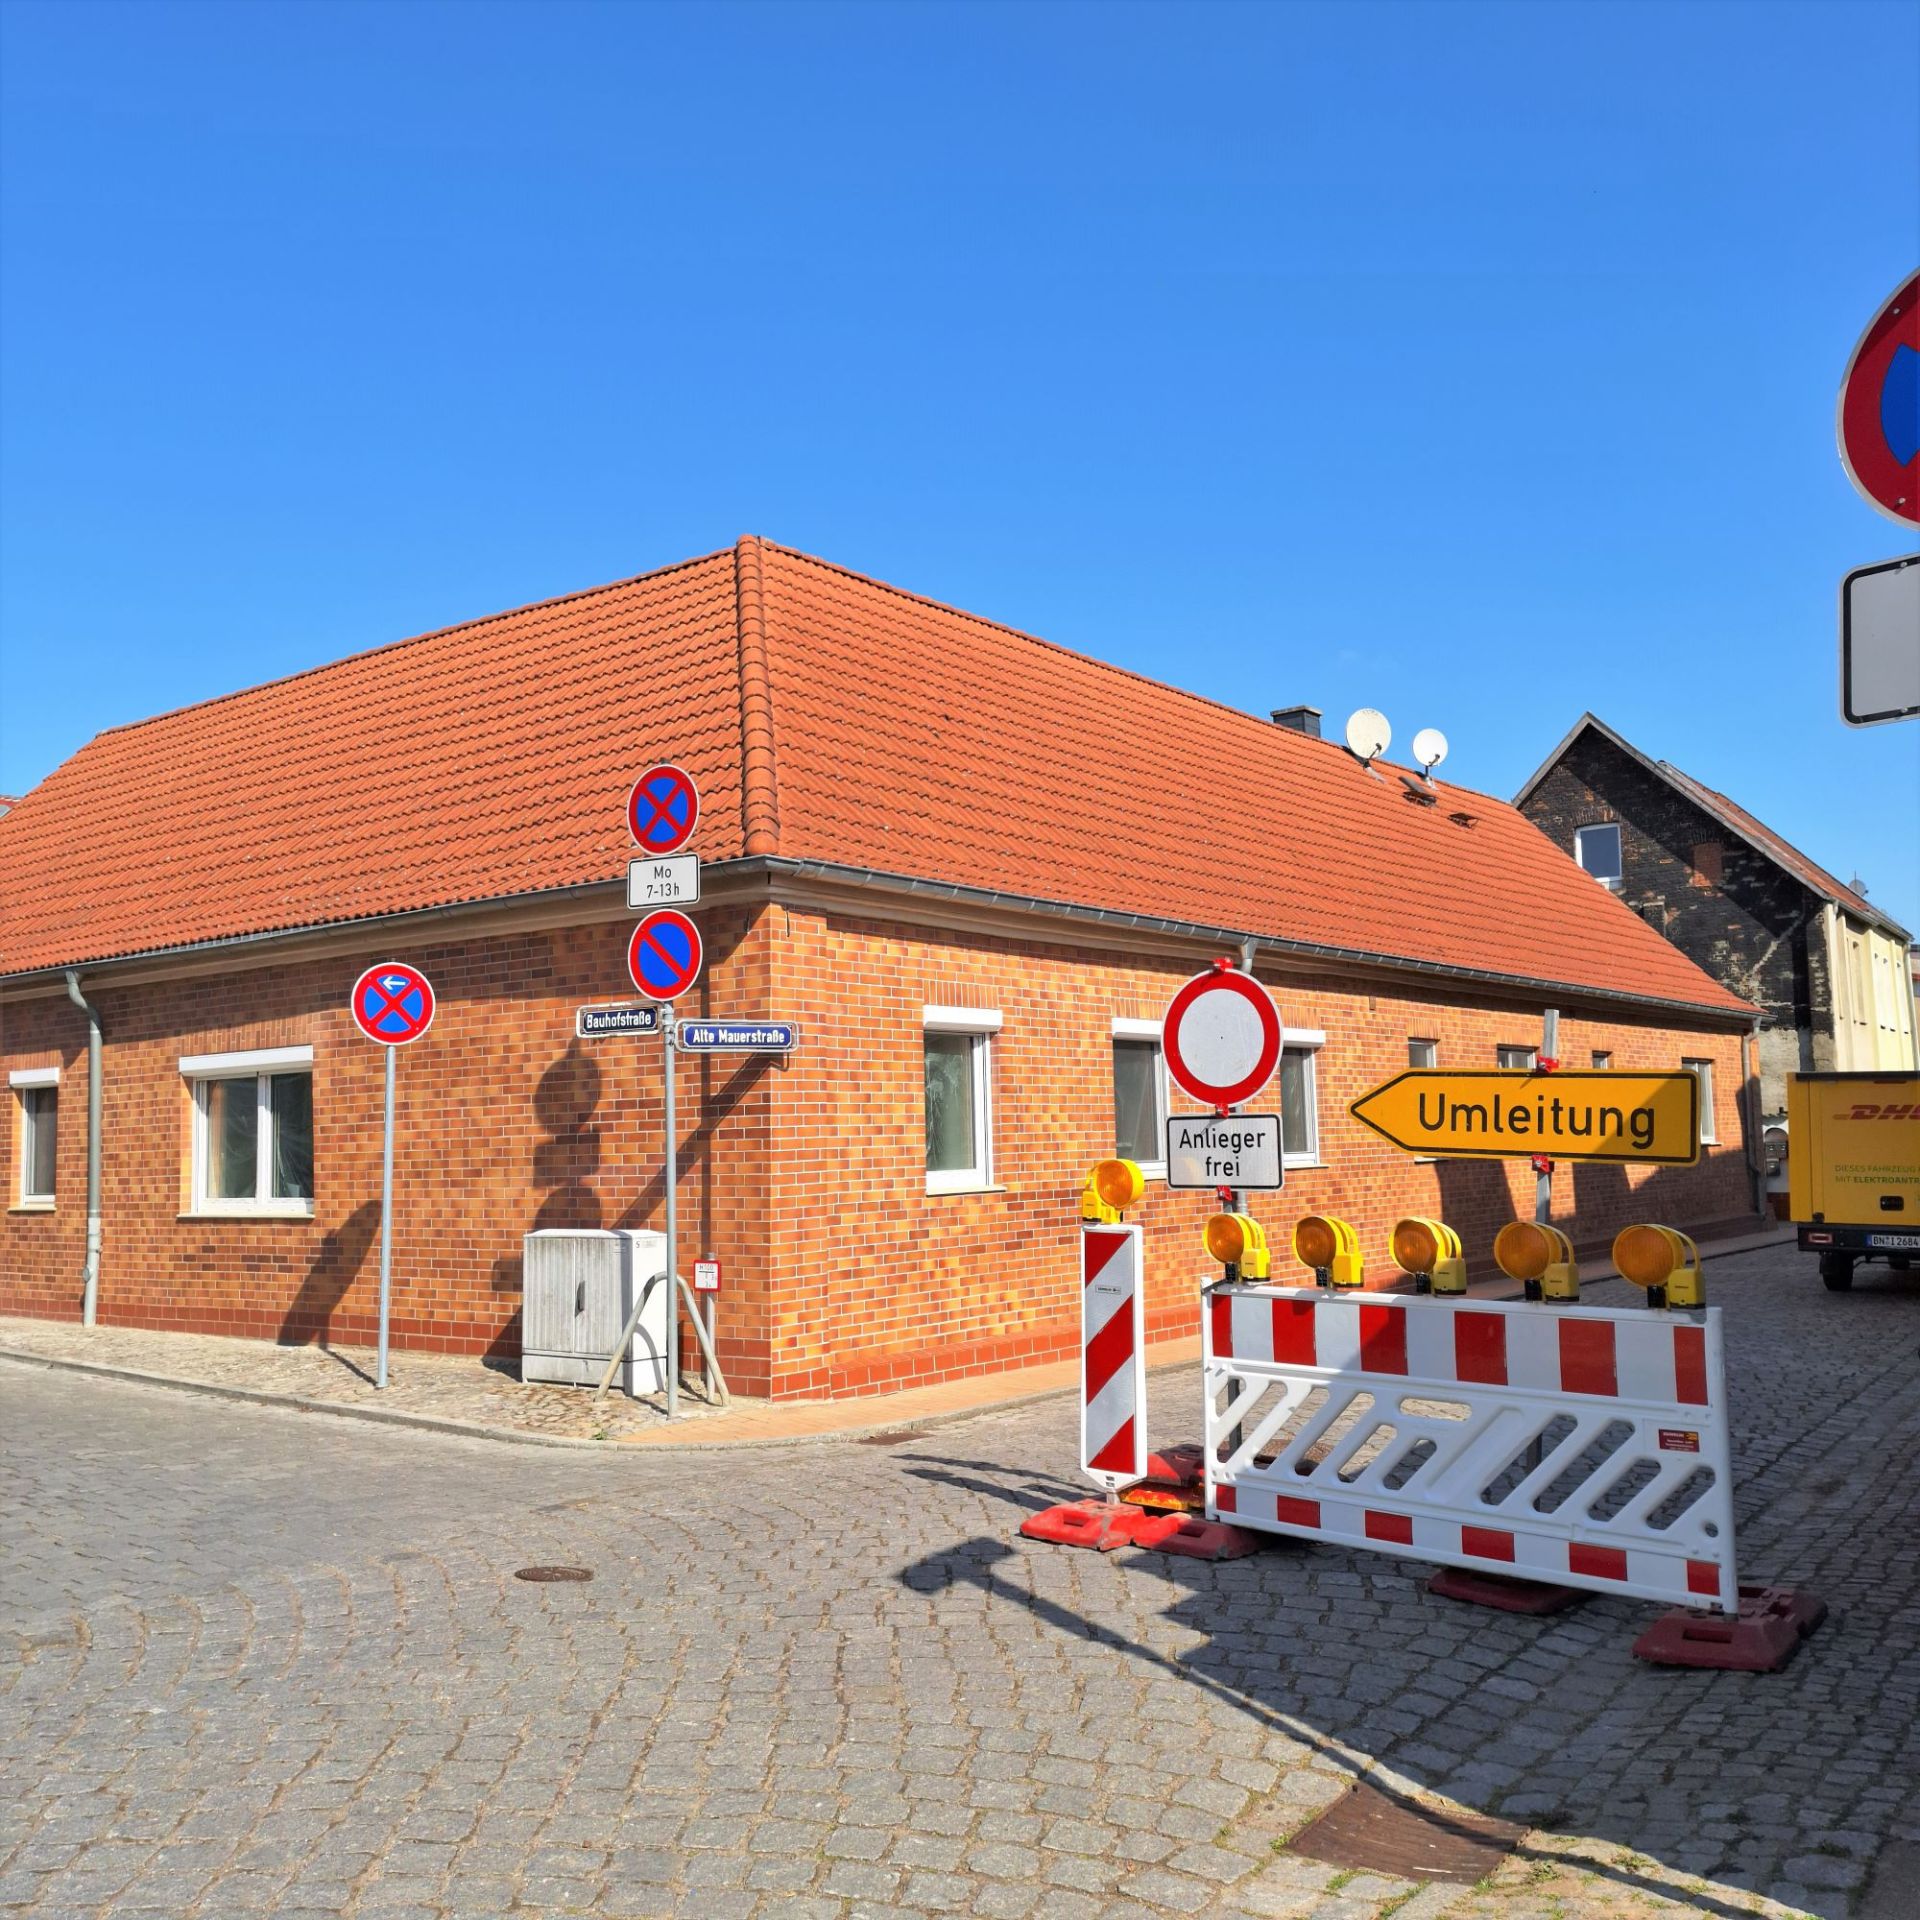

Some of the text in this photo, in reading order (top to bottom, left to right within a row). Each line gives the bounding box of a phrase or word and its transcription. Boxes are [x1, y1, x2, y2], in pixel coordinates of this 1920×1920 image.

[654, 866, 672, 879] Mo
[586, 1010, 652, 1029] Bauhofstraße
[692, 1029, 785, 1044] Alte Mauerstraße
[1418, 1092, 1655, 1150] Umleitung
[1179, 1128, 1266, 1153] Anlieger
[1205, 1156, 1240, 1177] frei
[1834, 1164, 1866, 1172] DIESES
